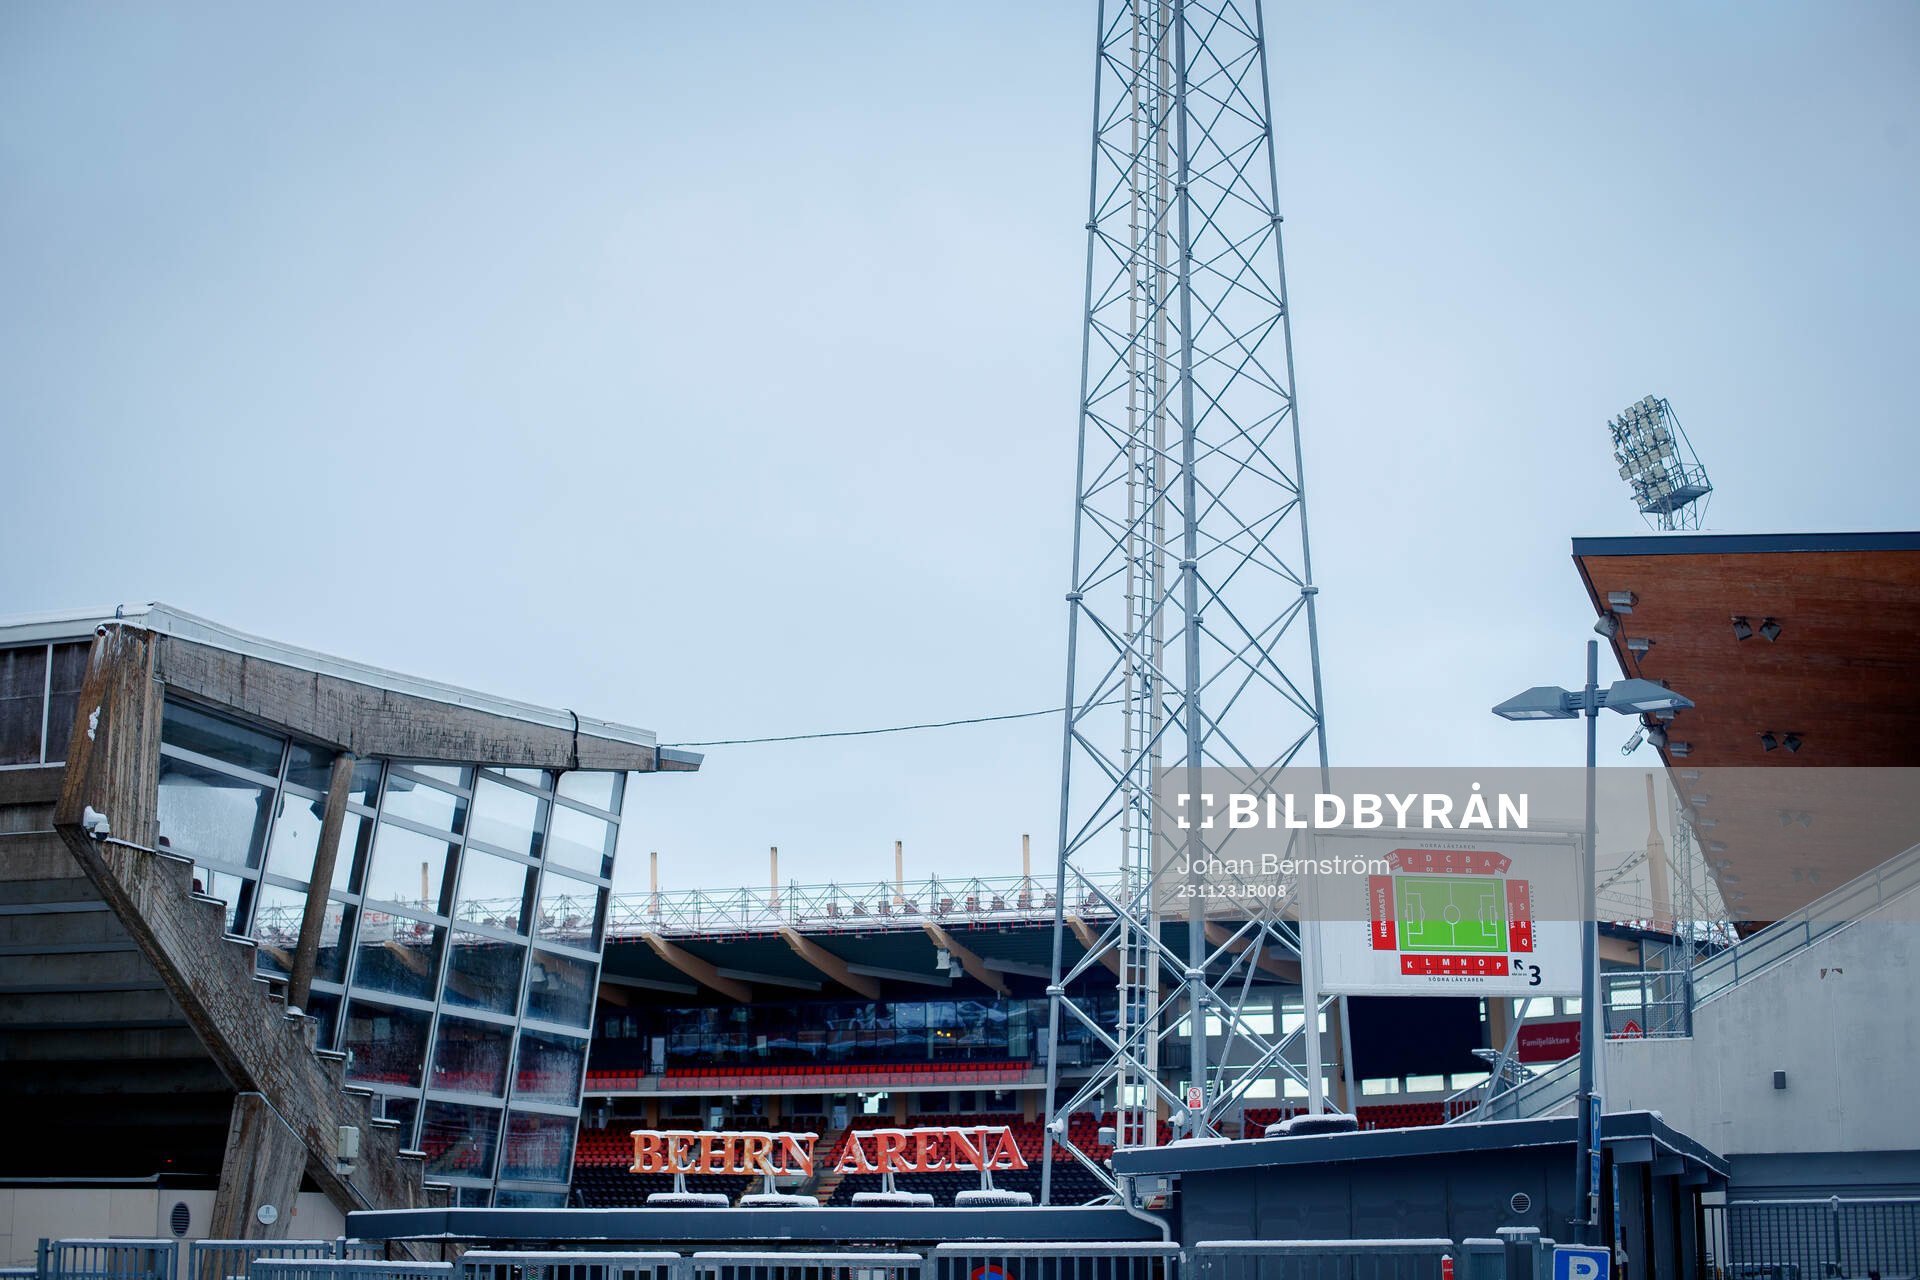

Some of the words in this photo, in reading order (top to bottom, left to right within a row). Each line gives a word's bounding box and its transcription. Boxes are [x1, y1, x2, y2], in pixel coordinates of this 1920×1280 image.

[1407, 857, 1413, 865] E
[1484, 859, 1490, 867] A
[1518, 885, 1524, 893] T
[1376, 887, 1388, 938] HEMMASTÅ
[1519, 903, 1525, 911] S
[1520, 921, 1526, 929] R
[1521, 938, 1528, 947] Q
[1407, 961, 1413, 969] K
[1425, 958, 1431, 966] L
[1442, 958, 1450, 966] M
[1478, 959, 1485, 967] O
[1528, 965, 1542, 986] 3
[1522, 1036, 1570, 1048] Familjeläktare
[629, 1130, 819, 1177] BEHRN
[833, 1126, 1028, 1174] ARENA
[1569, 1256, 1599, 1280] P
